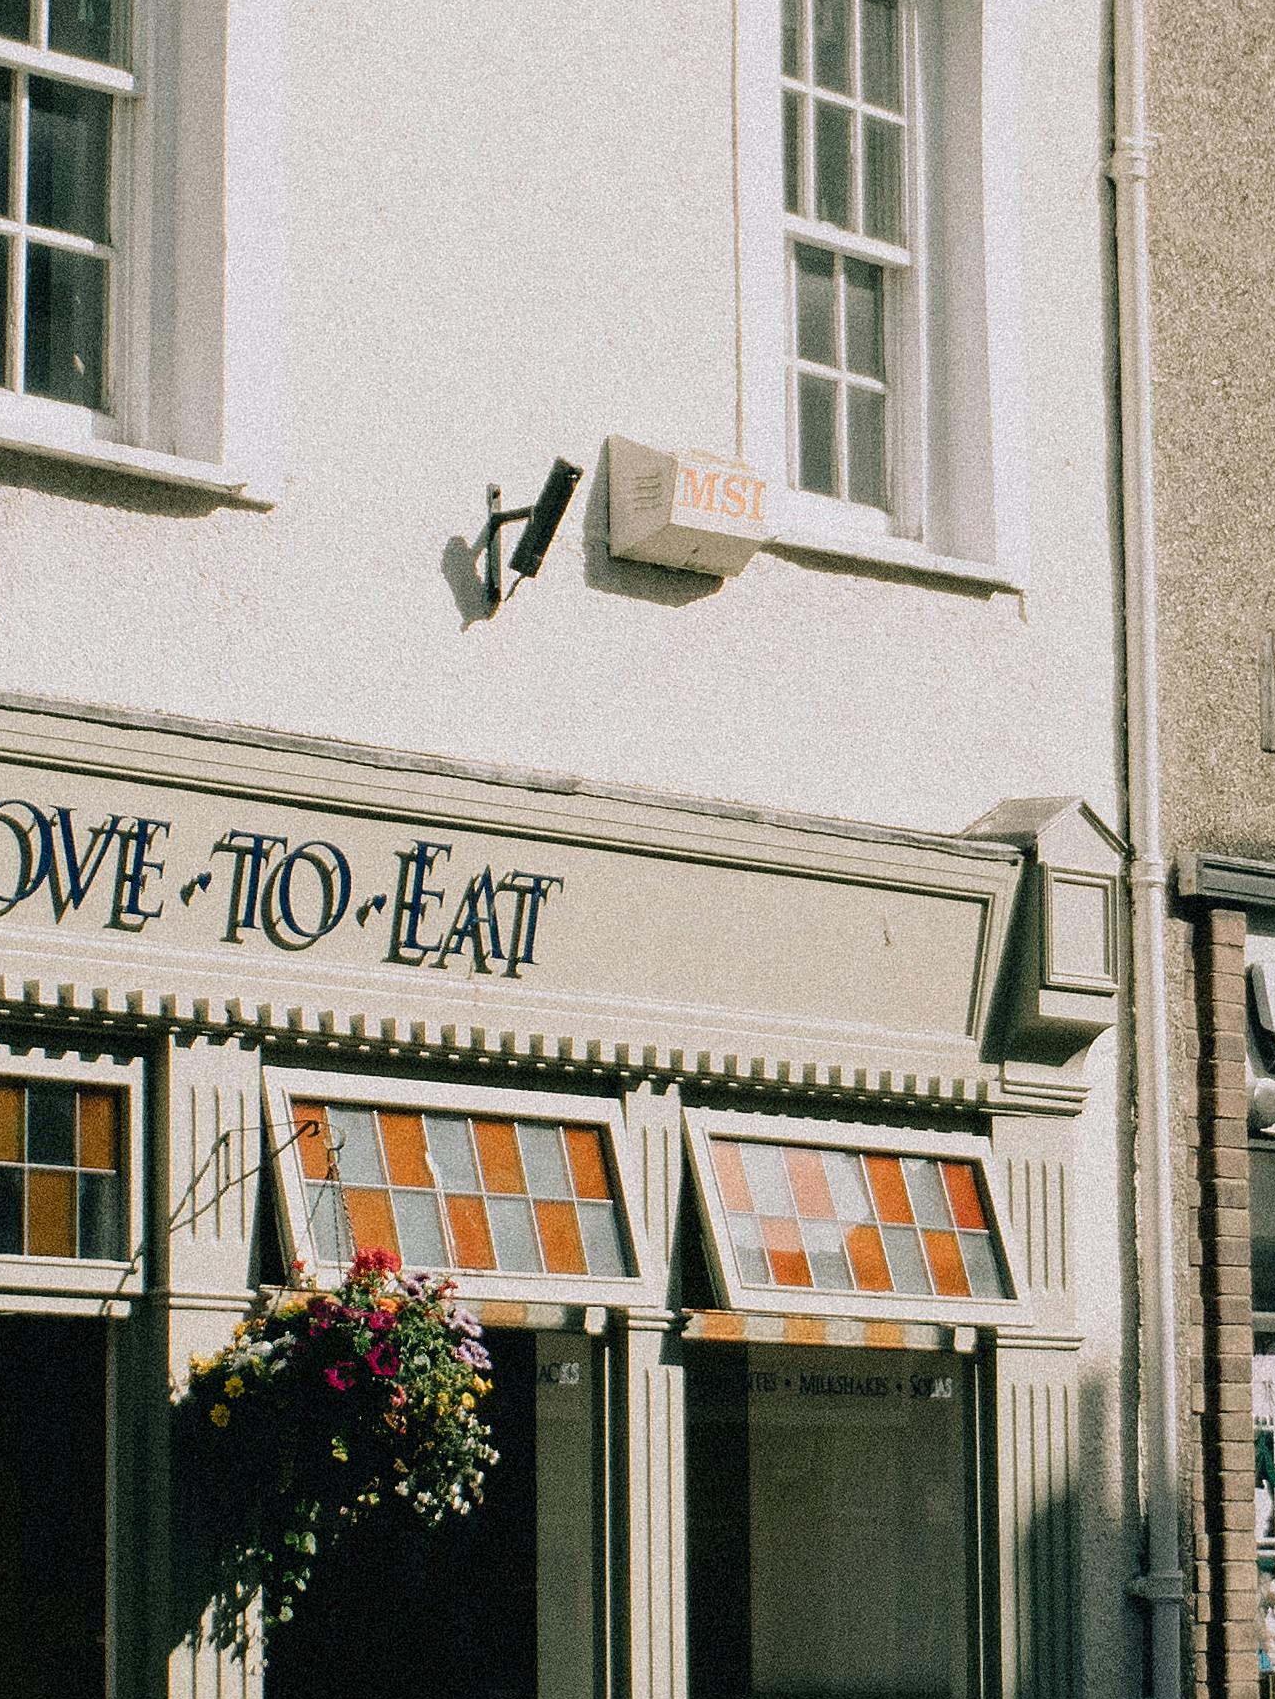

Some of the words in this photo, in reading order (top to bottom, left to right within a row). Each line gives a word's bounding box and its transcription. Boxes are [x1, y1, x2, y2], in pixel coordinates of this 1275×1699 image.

[677, 466, 767, 522] MSI
[227, 830, 353, 939] TO
[403, 840, 565, 967] EAT
[799, 1372, 889, 1397] MILKSHAKES
